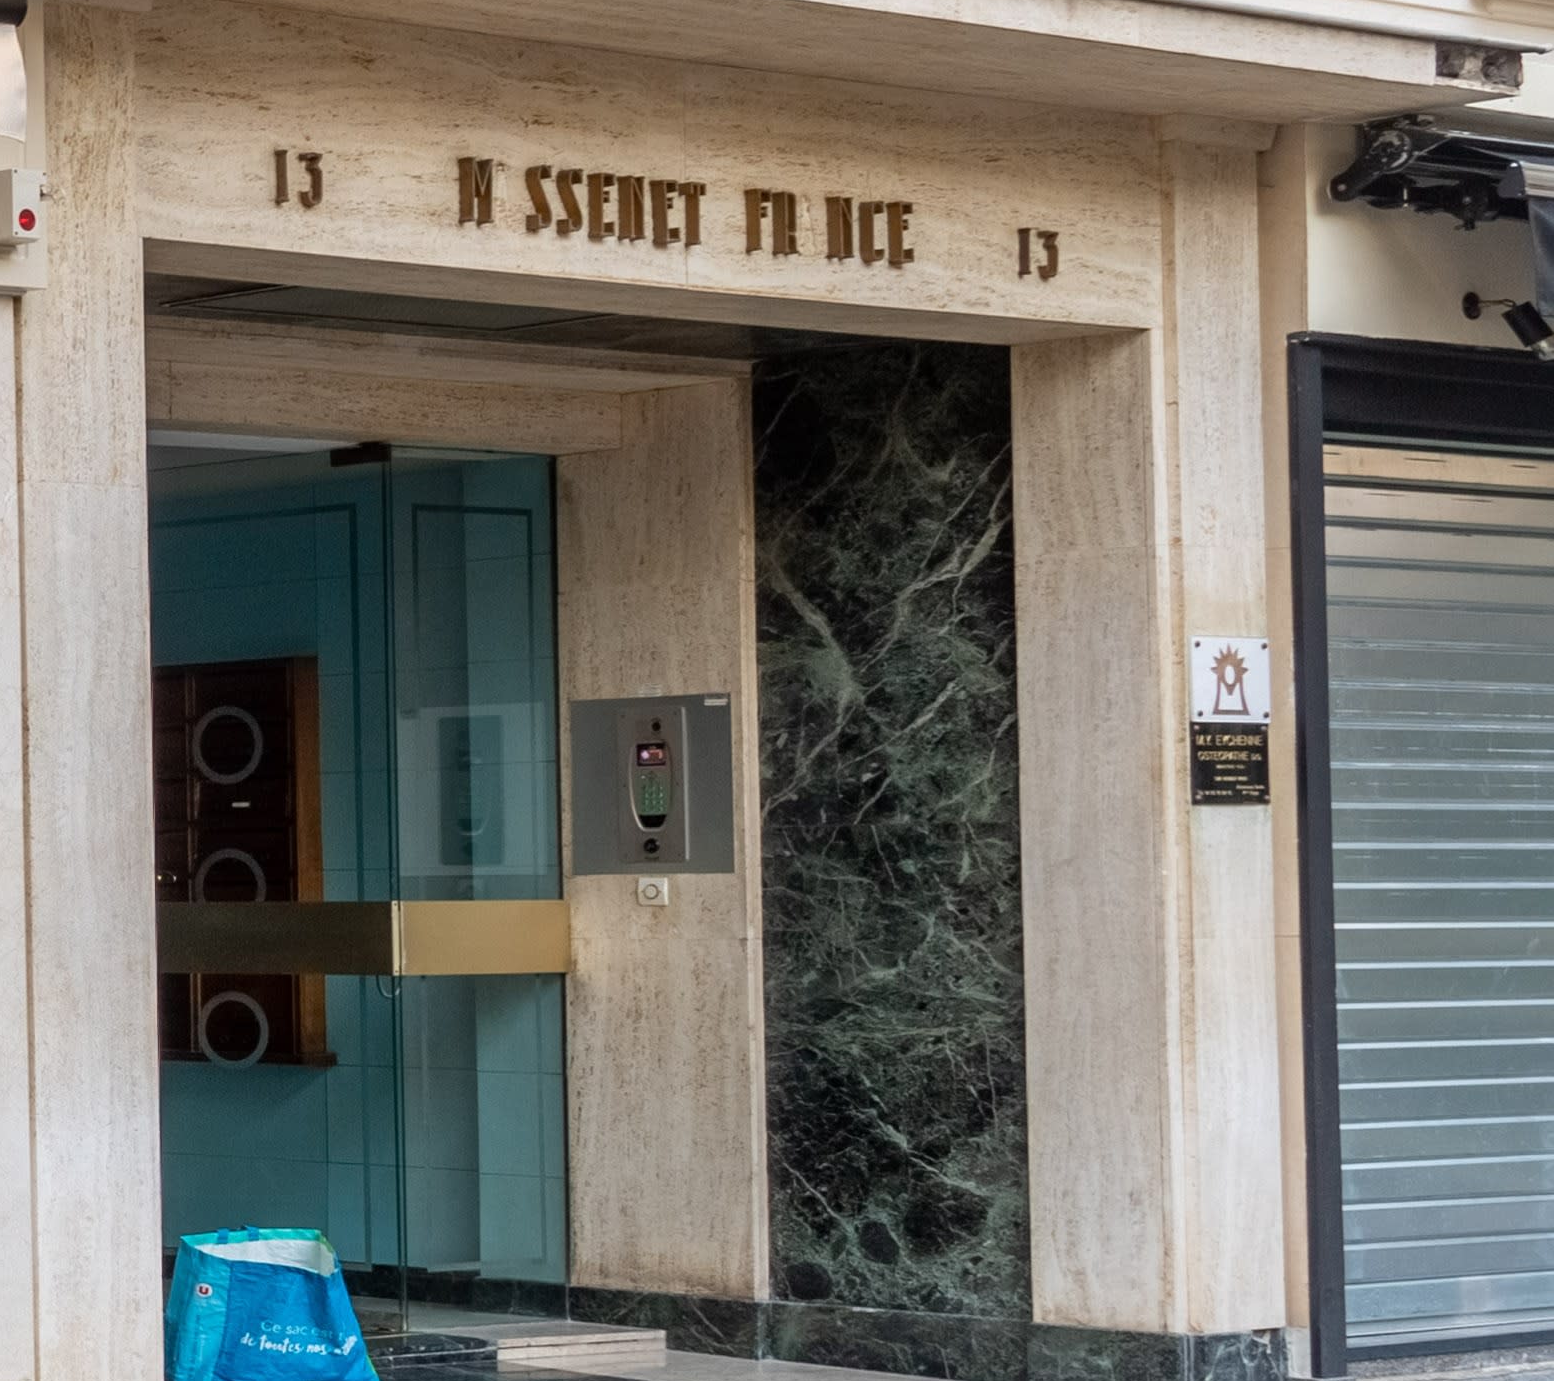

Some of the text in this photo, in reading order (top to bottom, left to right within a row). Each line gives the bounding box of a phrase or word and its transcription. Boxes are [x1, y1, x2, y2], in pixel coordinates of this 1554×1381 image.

[273, 148, 1060, 282] 13 MSSENET FRNCE 13
[199, 1286, 209, 1295] U
[260, 1319, 282, 1333] Ce
[285, 1324, 308, 1336] sac
[240, 1332, 256, 1347] de
[259, 1334, 303, 1354] toutes
[306, 1343, 327, 1356] nos
